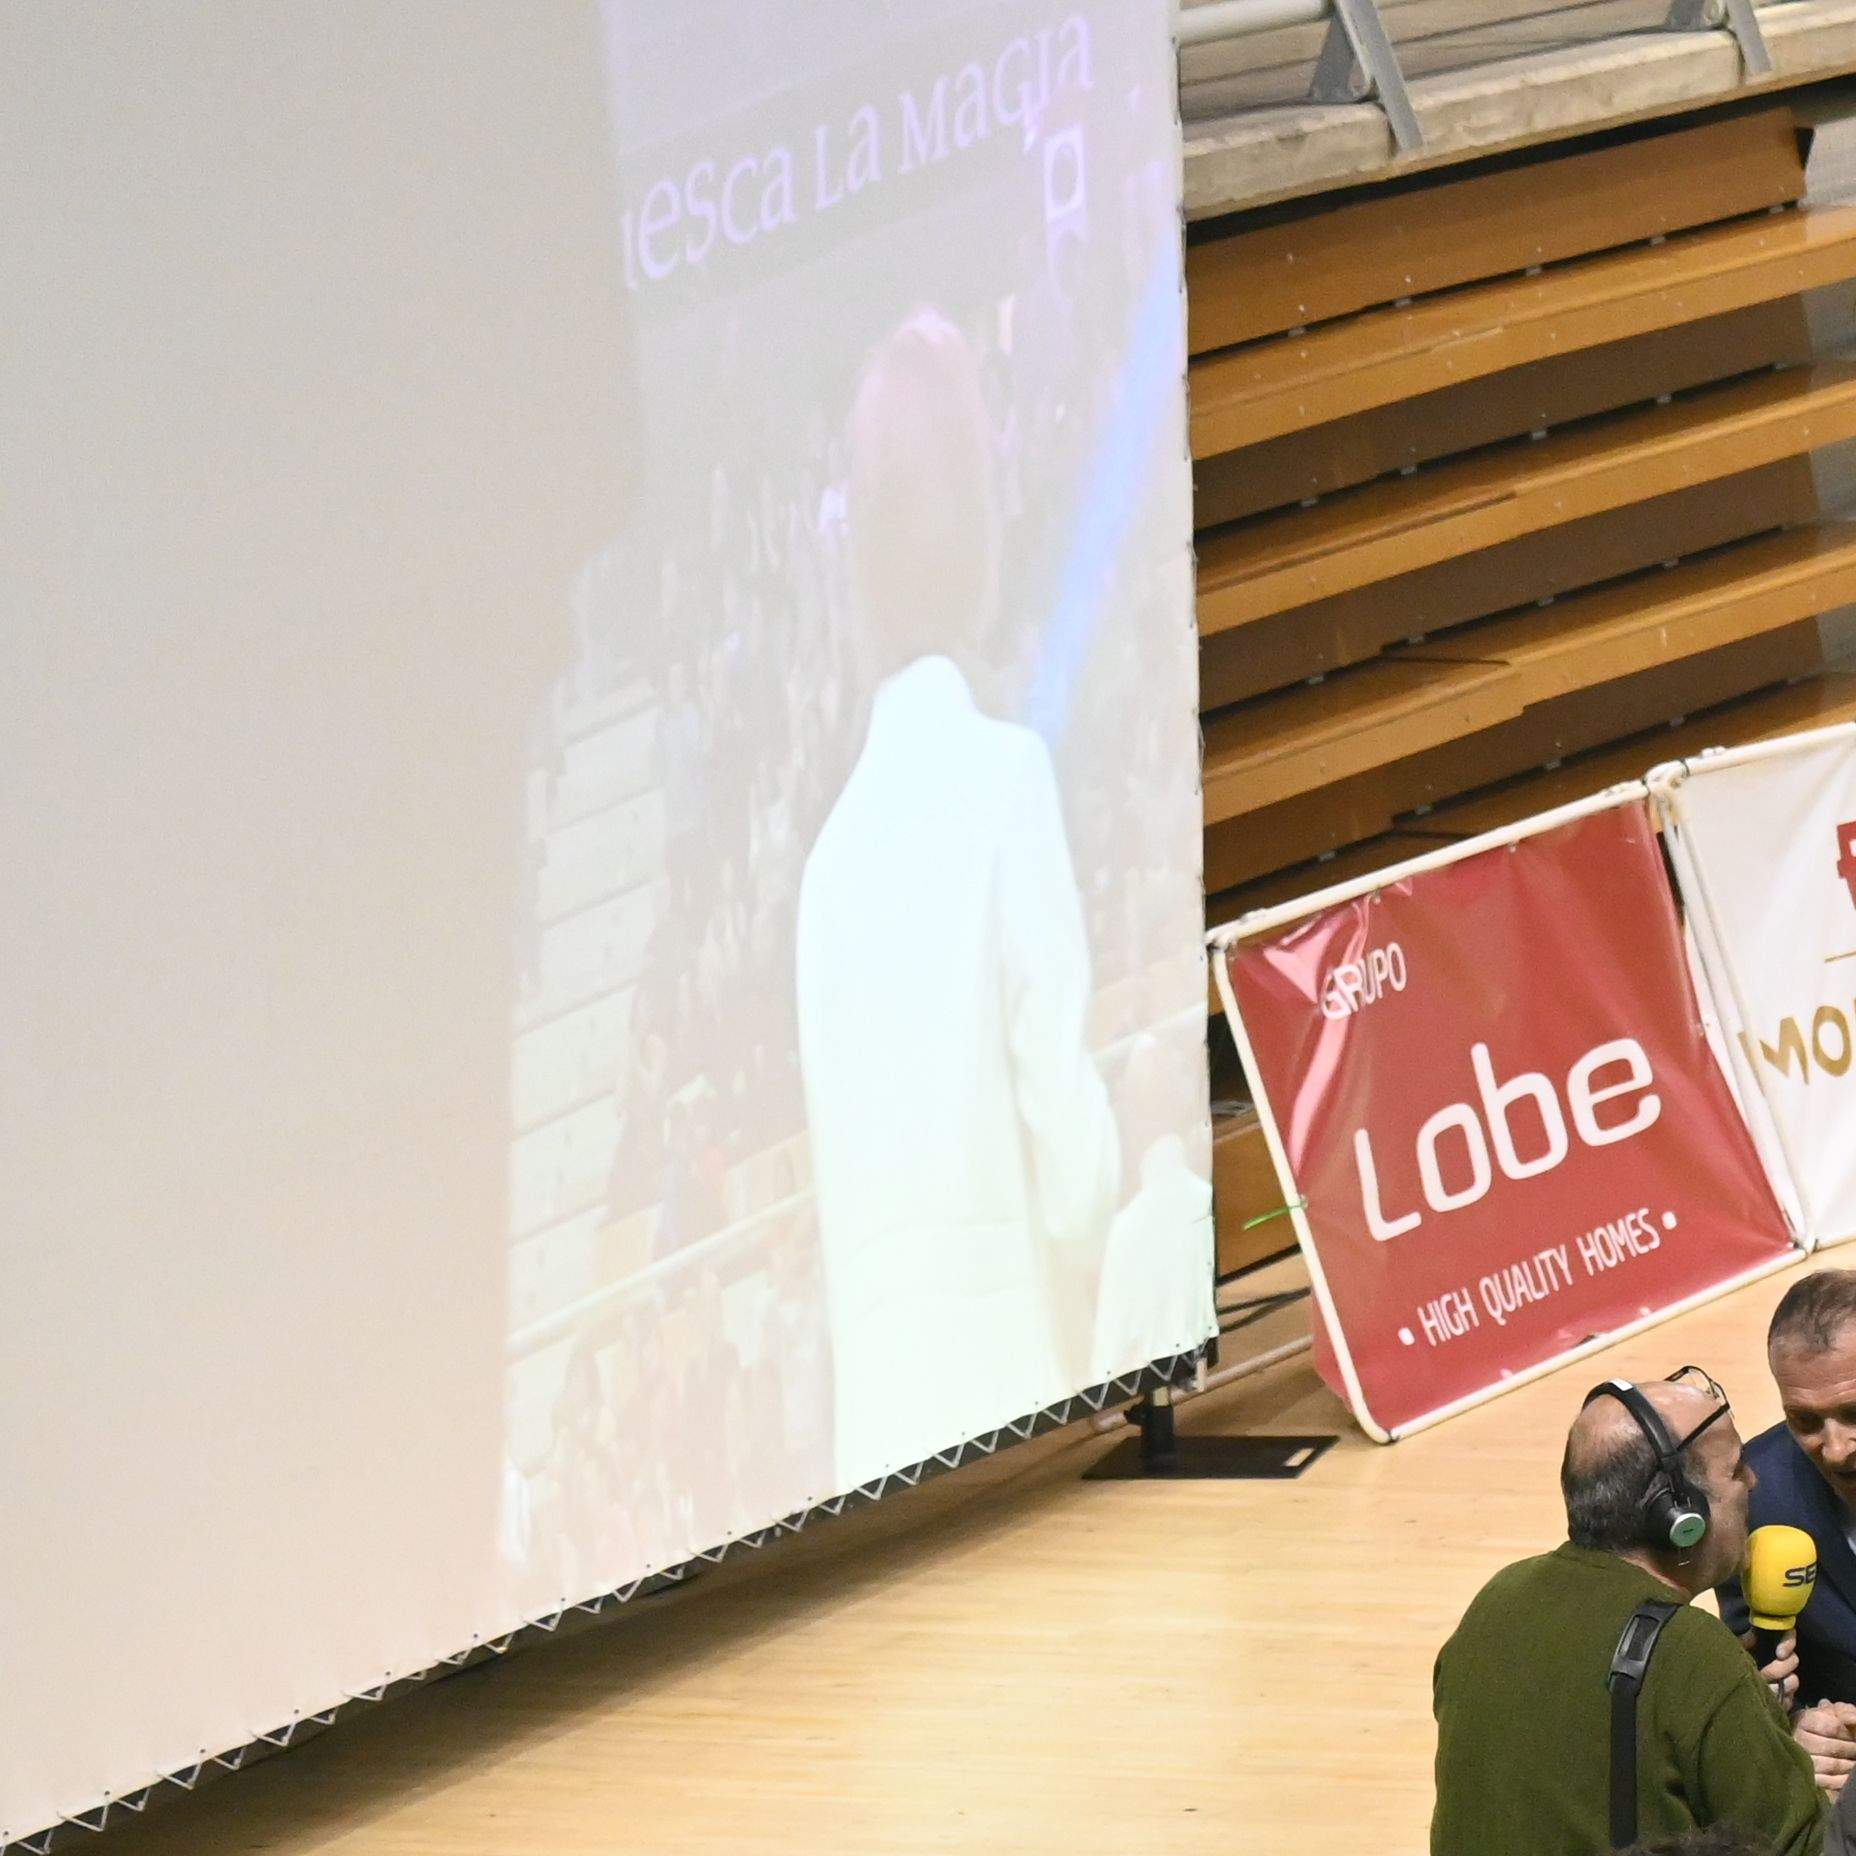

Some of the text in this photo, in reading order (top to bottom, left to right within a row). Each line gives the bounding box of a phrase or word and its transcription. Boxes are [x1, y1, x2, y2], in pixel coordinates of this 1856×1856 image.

[813, 104, 882, 213] La
[1320, 942, 1407, 1020] GRUPO
[1416, 1208, 1660, 1347] HIGH QUALITY HOMES
